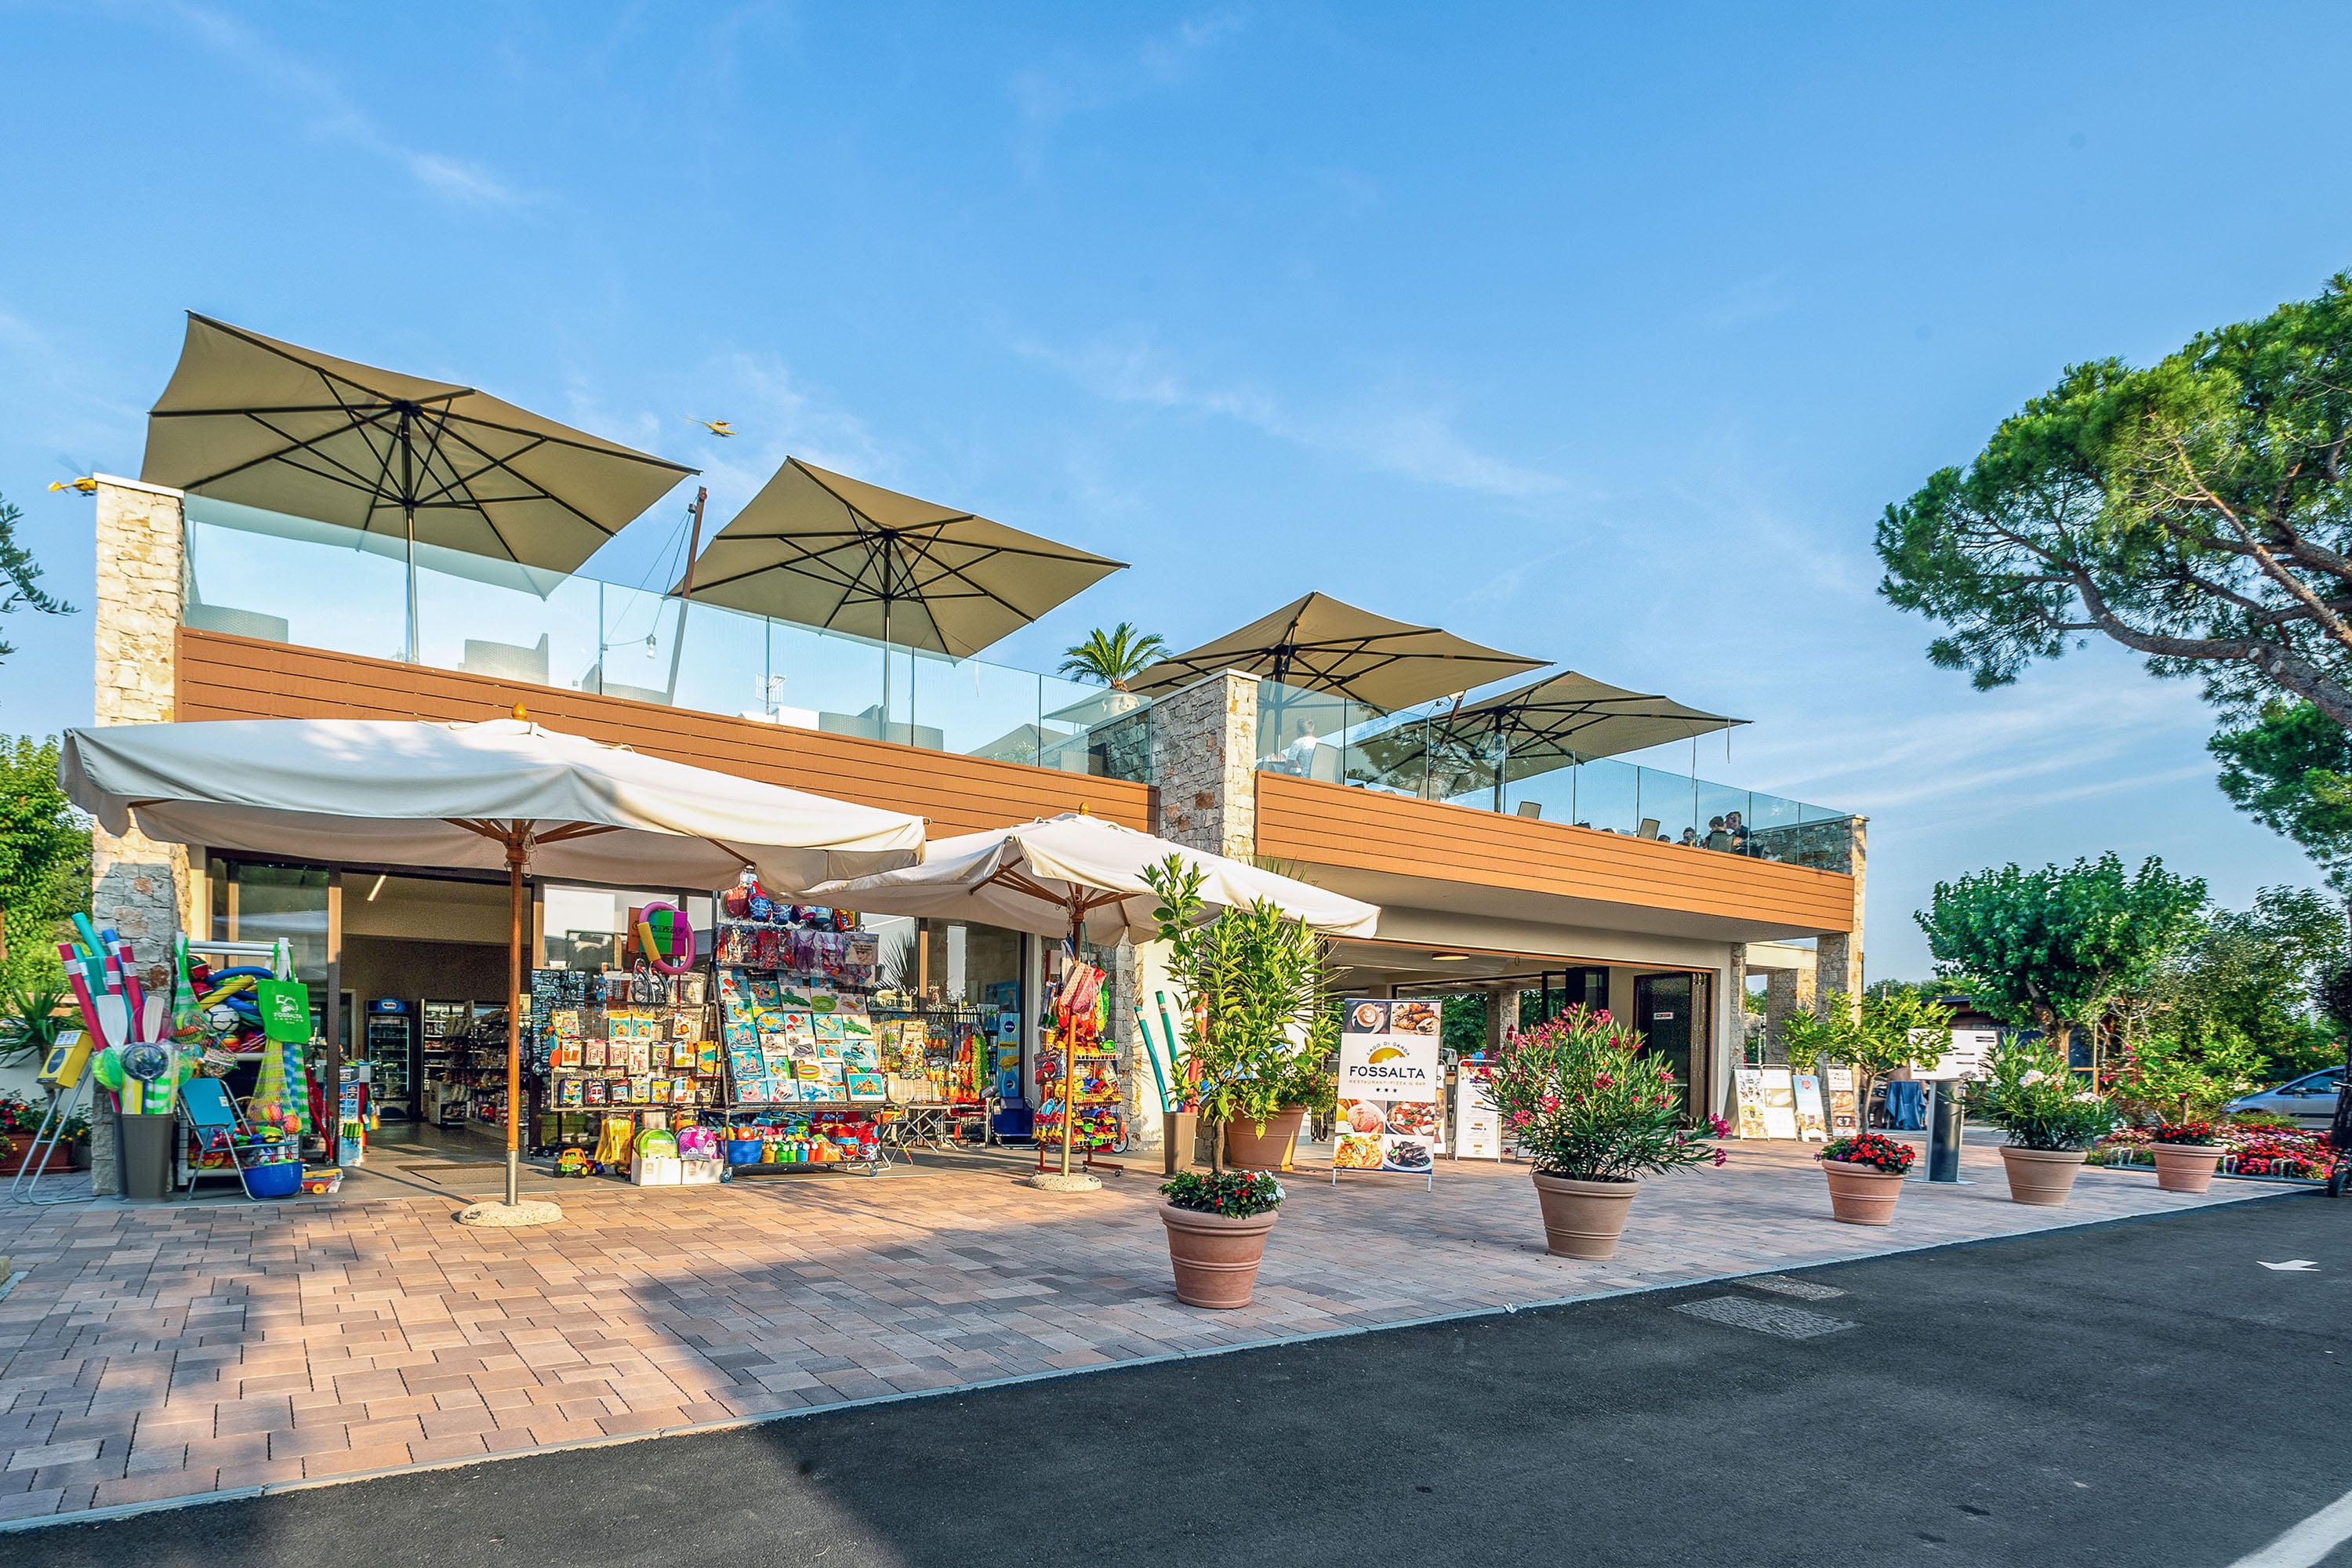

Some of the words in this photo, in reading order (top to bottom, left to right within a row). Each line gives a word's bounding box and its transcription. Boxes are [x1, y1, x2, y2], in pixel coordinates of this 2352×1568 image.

[1367, 1043, 1381, 1056] LAGO
[1392, 1041, 1410, 1056] GARDA
[1349, 1065, 1426, 1080] FOSSALTA
[1837, 1116, 1851, 1127] €7
